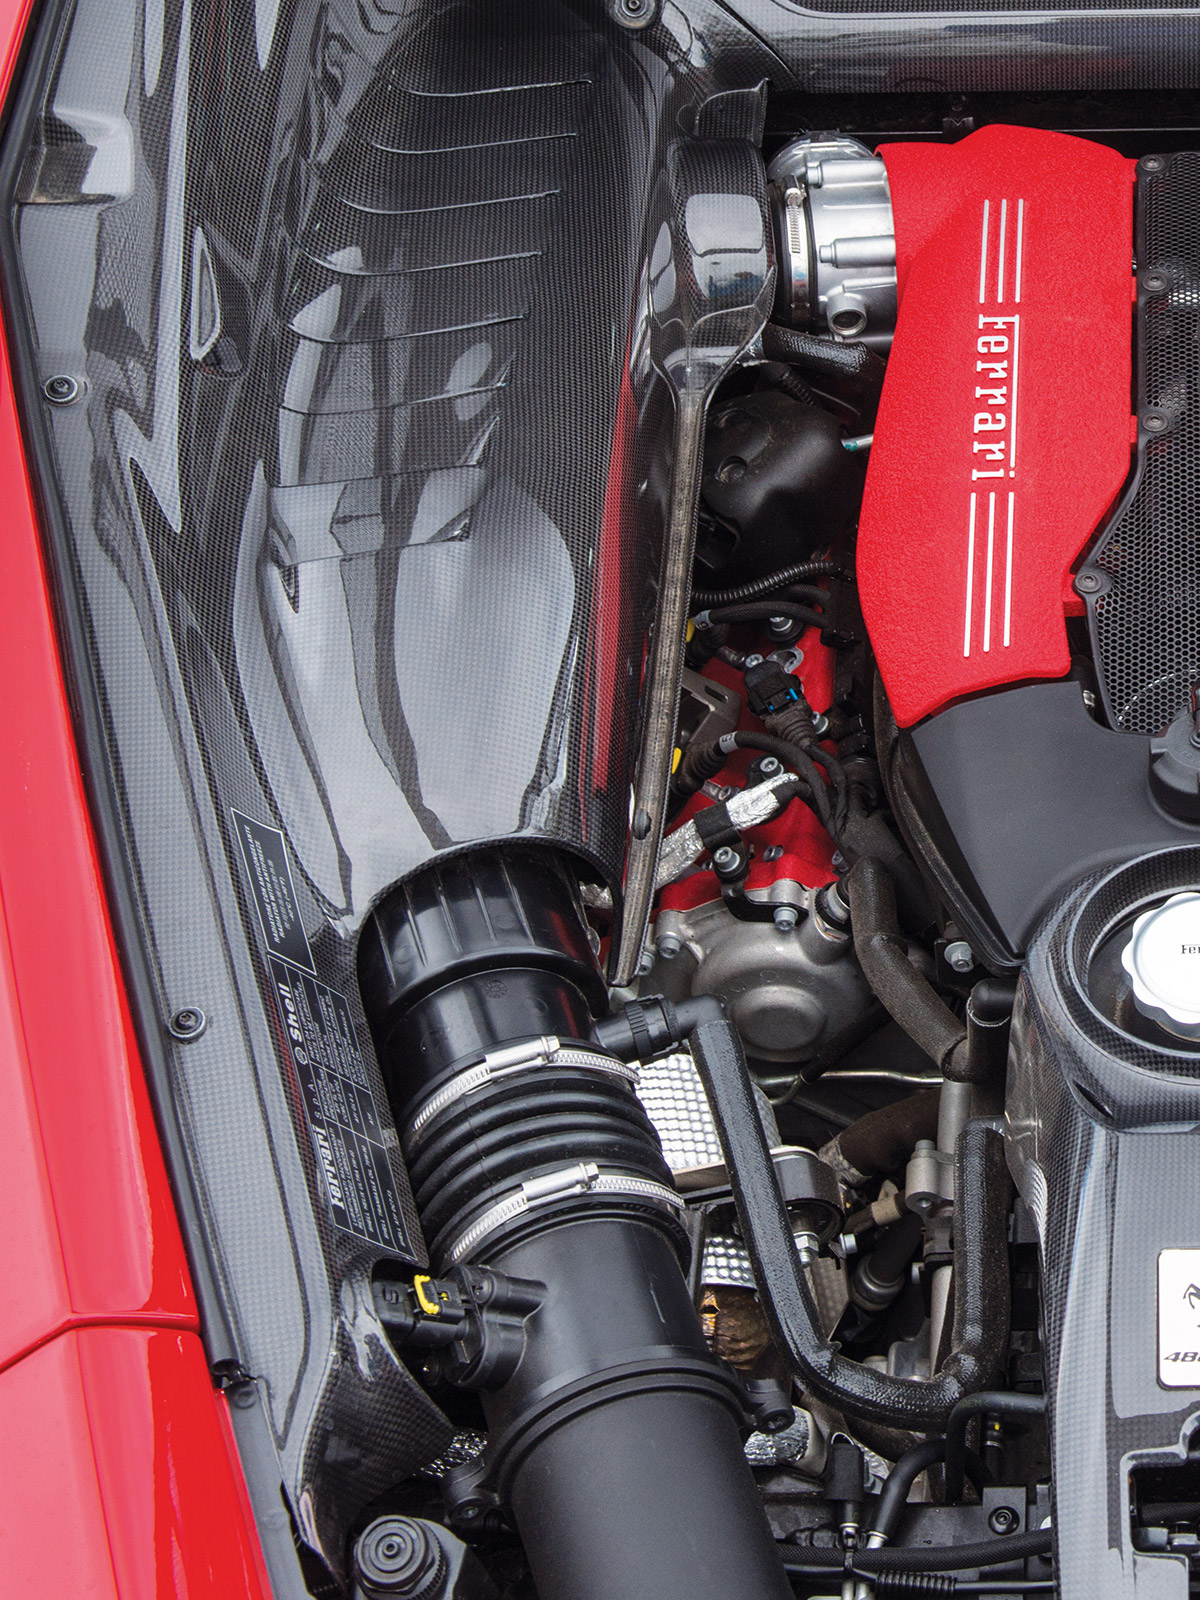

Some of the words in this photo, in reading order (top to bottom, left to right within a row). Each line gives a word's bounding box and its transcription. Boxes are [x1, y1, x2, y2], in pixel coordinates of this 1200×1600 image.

[971, 314, 1020, 481] Ferrari
[243, 824, 265, 887] ANTICONGELANTE
[254, 839, 270, 882] ANTIFREEZE
[265, 881, 275, 901] WITH
[263, 901, 280, 944] RADIATORE
[270, 900, 285, 938] RADIATOR
[277, 981, 303, 1043] Shell
[311, 1123, 345, 1210] Ferrari
